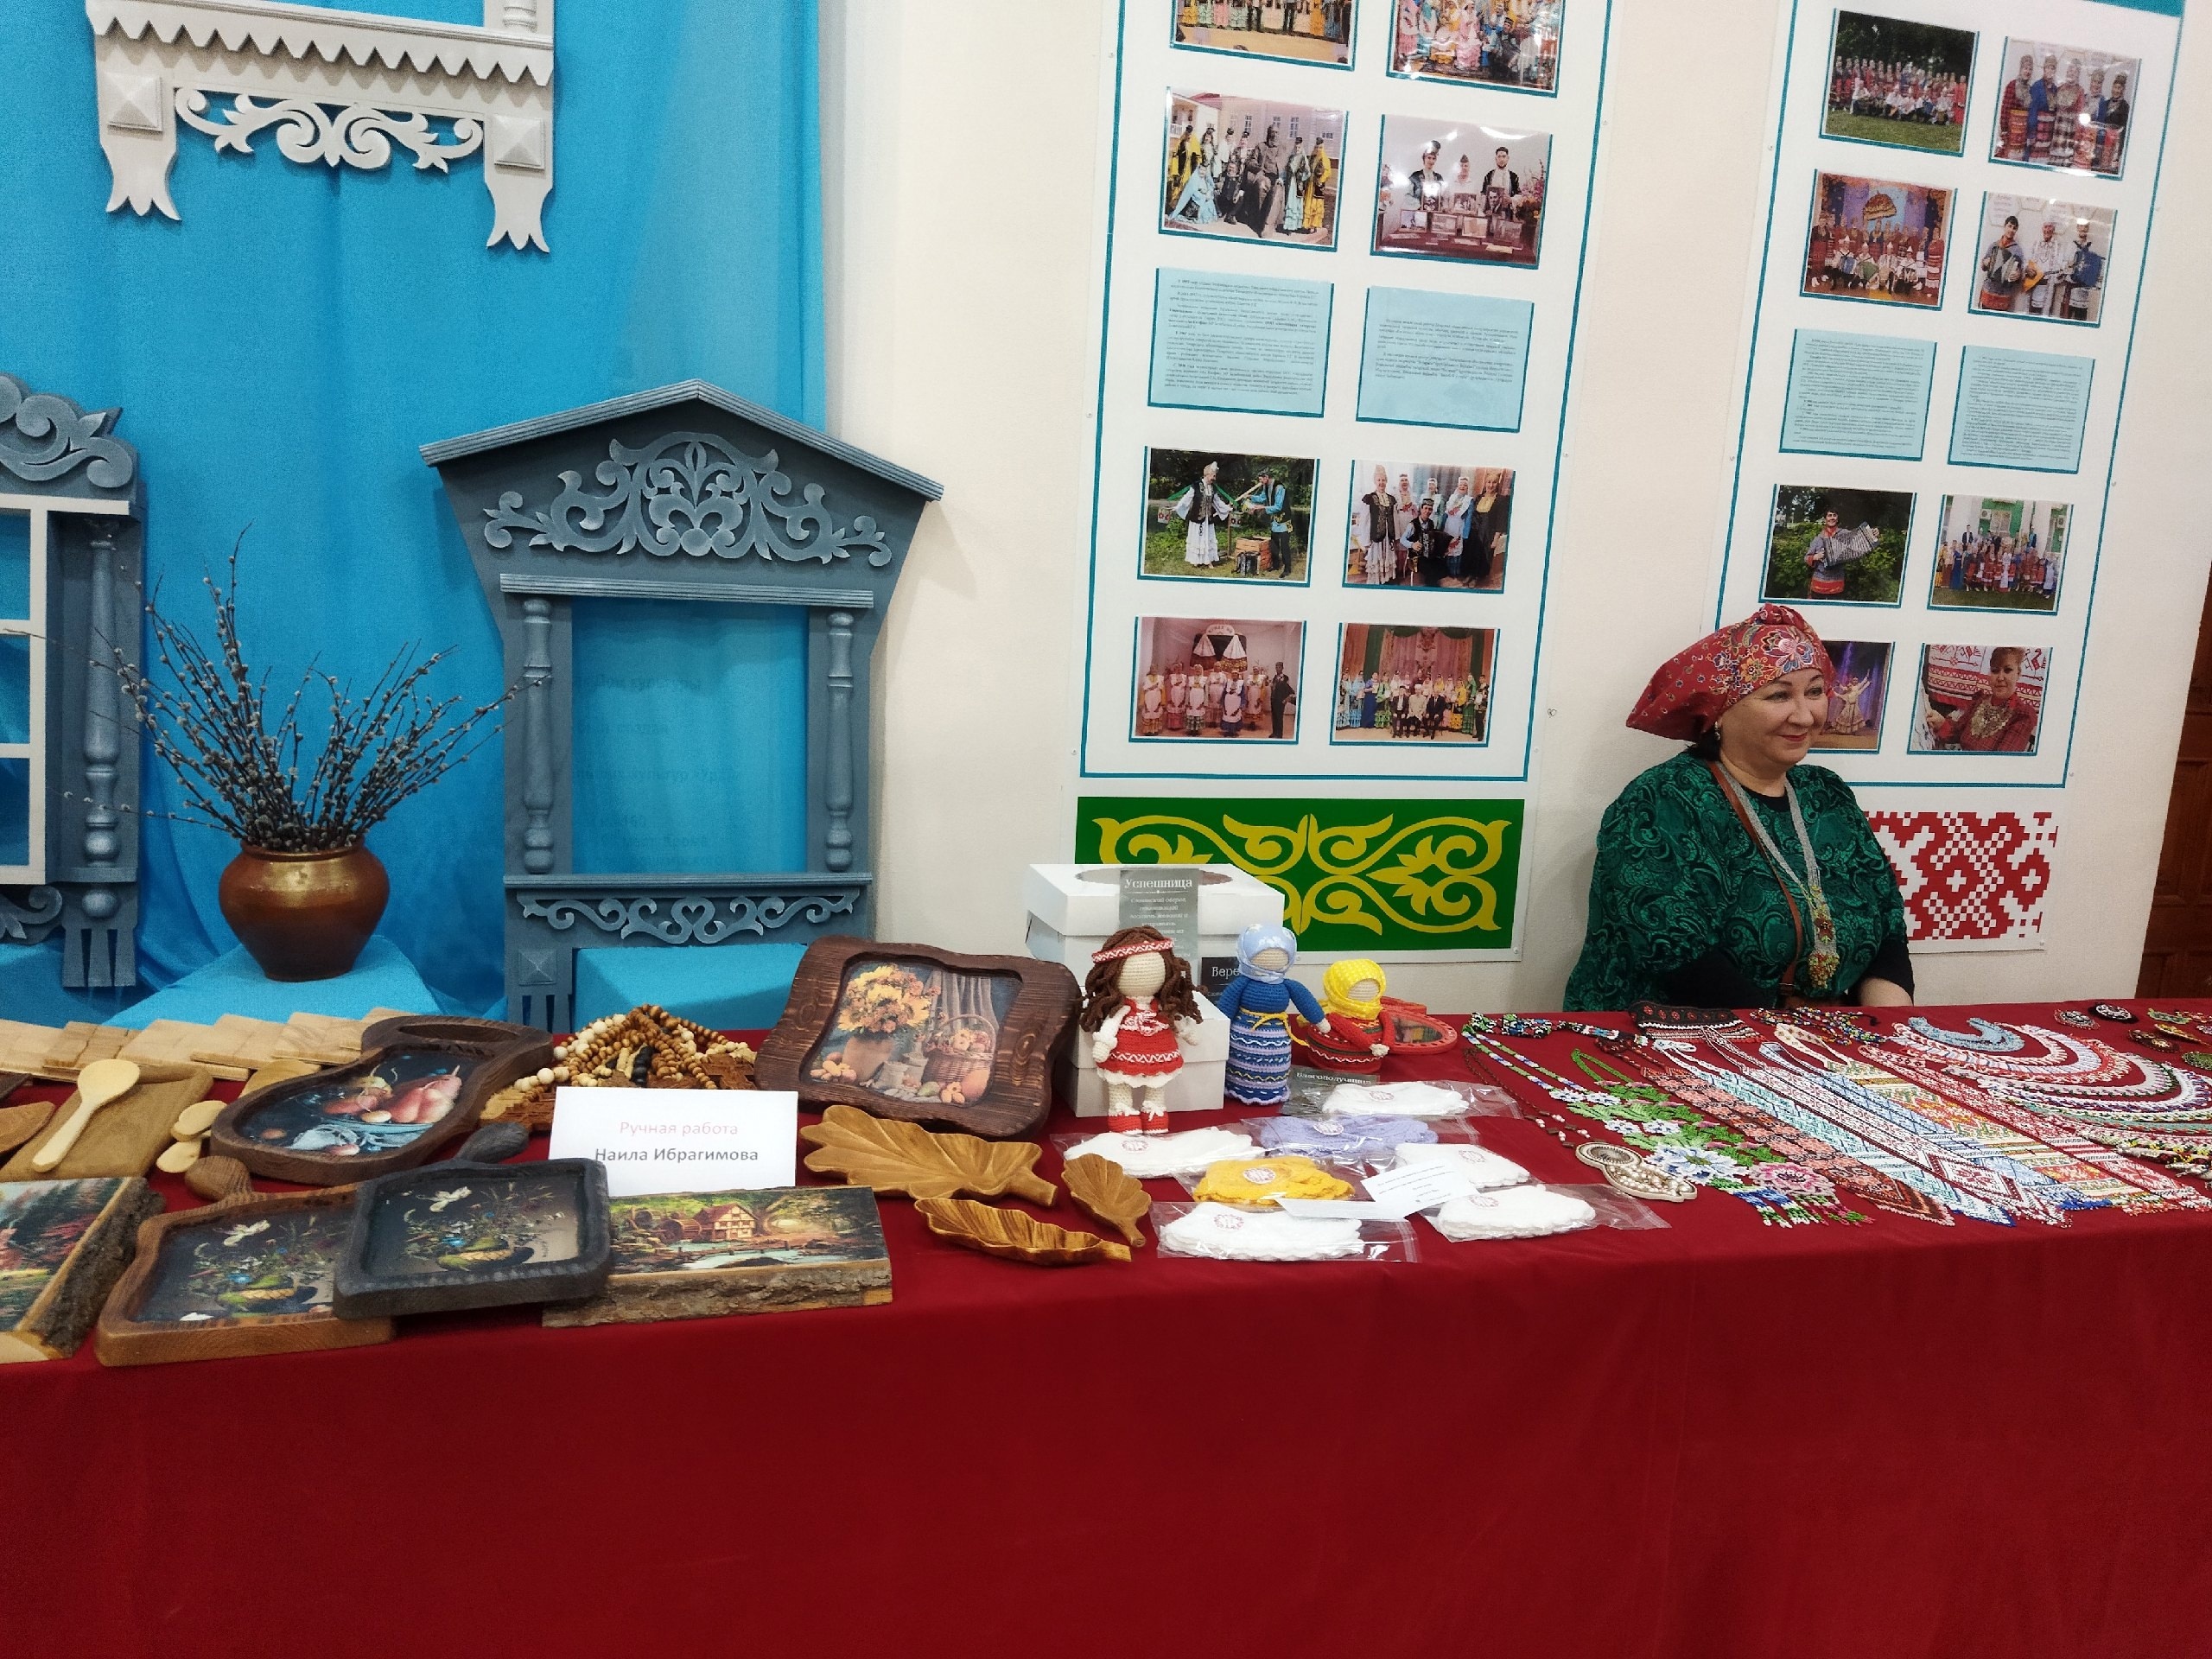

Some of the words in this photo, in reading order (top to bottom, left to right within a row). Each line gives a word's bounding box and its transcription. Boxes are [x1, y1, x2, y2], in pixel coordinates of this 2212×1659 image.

[1124, 879, 1192, 889] Успешница
[1211, 966, 1239, 980] Бере
[619, 1122, 677, 1137] Ручная
[682, 1122, 738, 1137] работа
[594, 1148, 648, 1161] Наила
[654, 1147, 759, 1163] Ибрагимова
